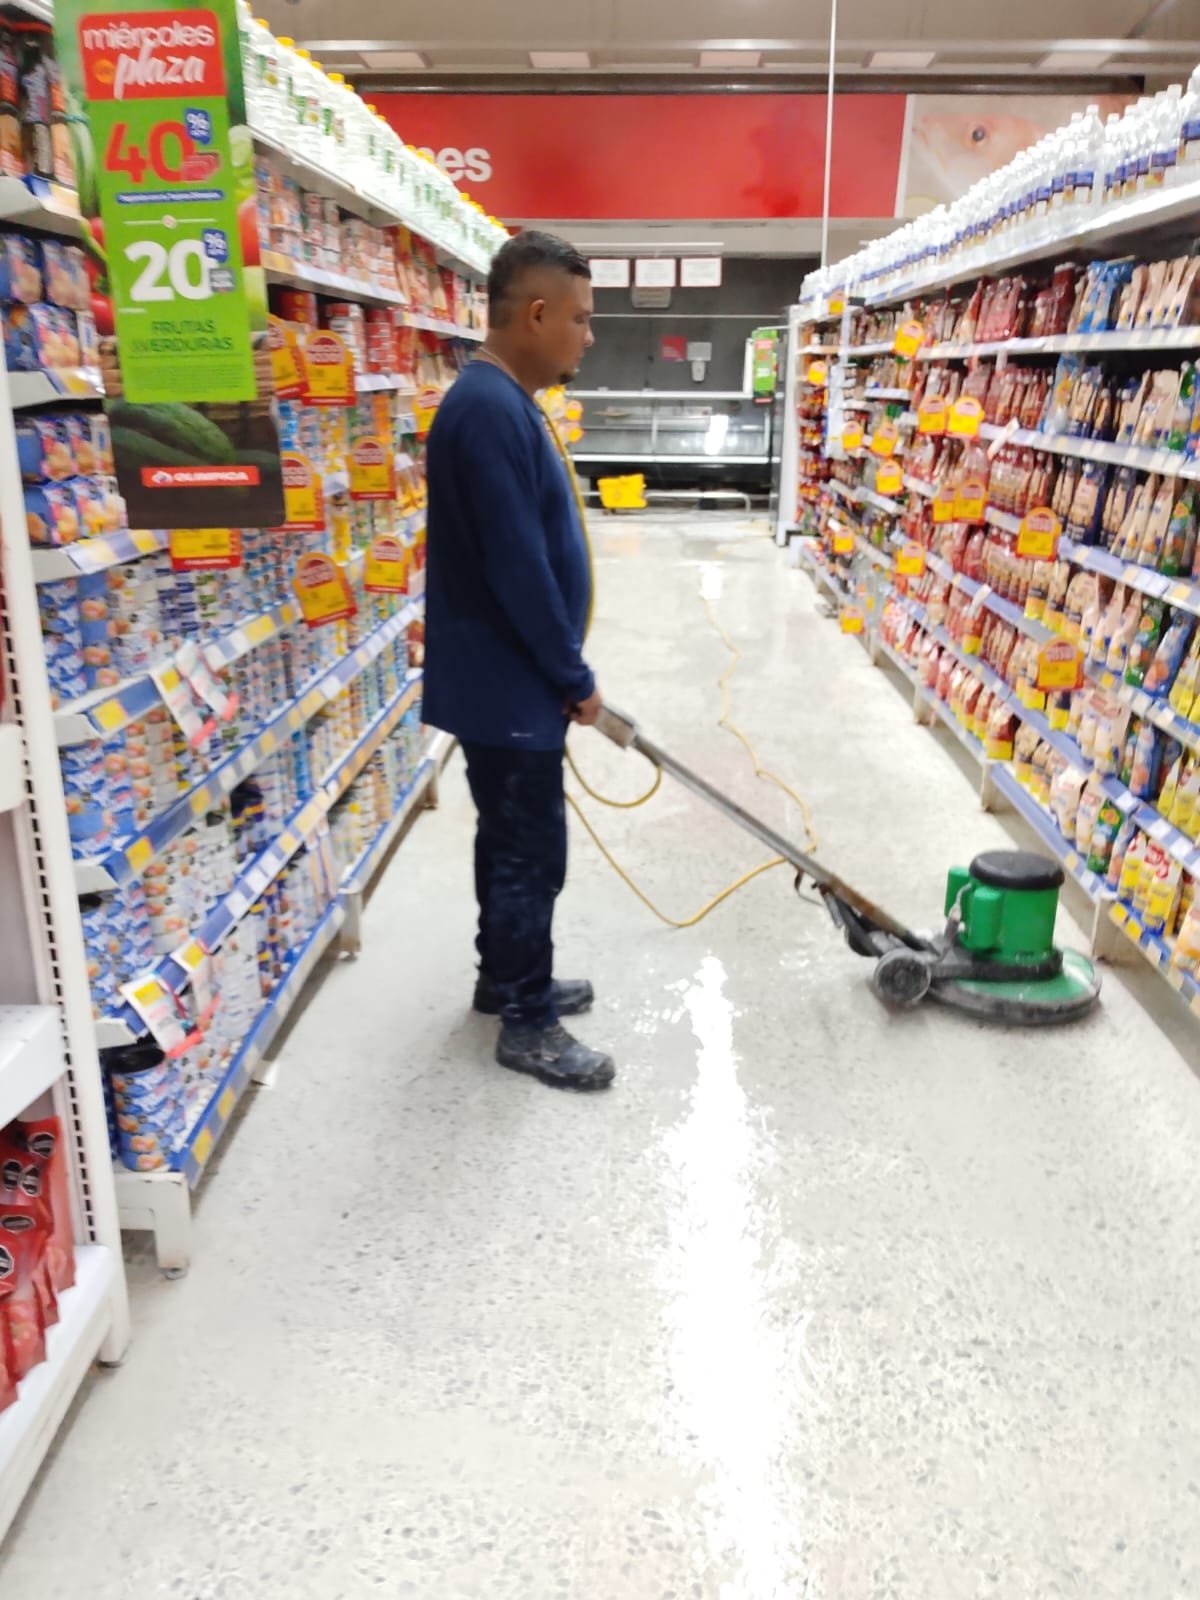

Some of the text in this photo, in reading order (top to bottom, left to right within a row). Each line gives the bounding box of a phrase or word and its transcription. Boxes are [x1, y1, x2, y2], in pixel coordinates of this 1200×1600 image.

[113, 41, 206, 100] plaza
[106, 122, 196, 184] 40
[124, 238, 218, 302] 20
